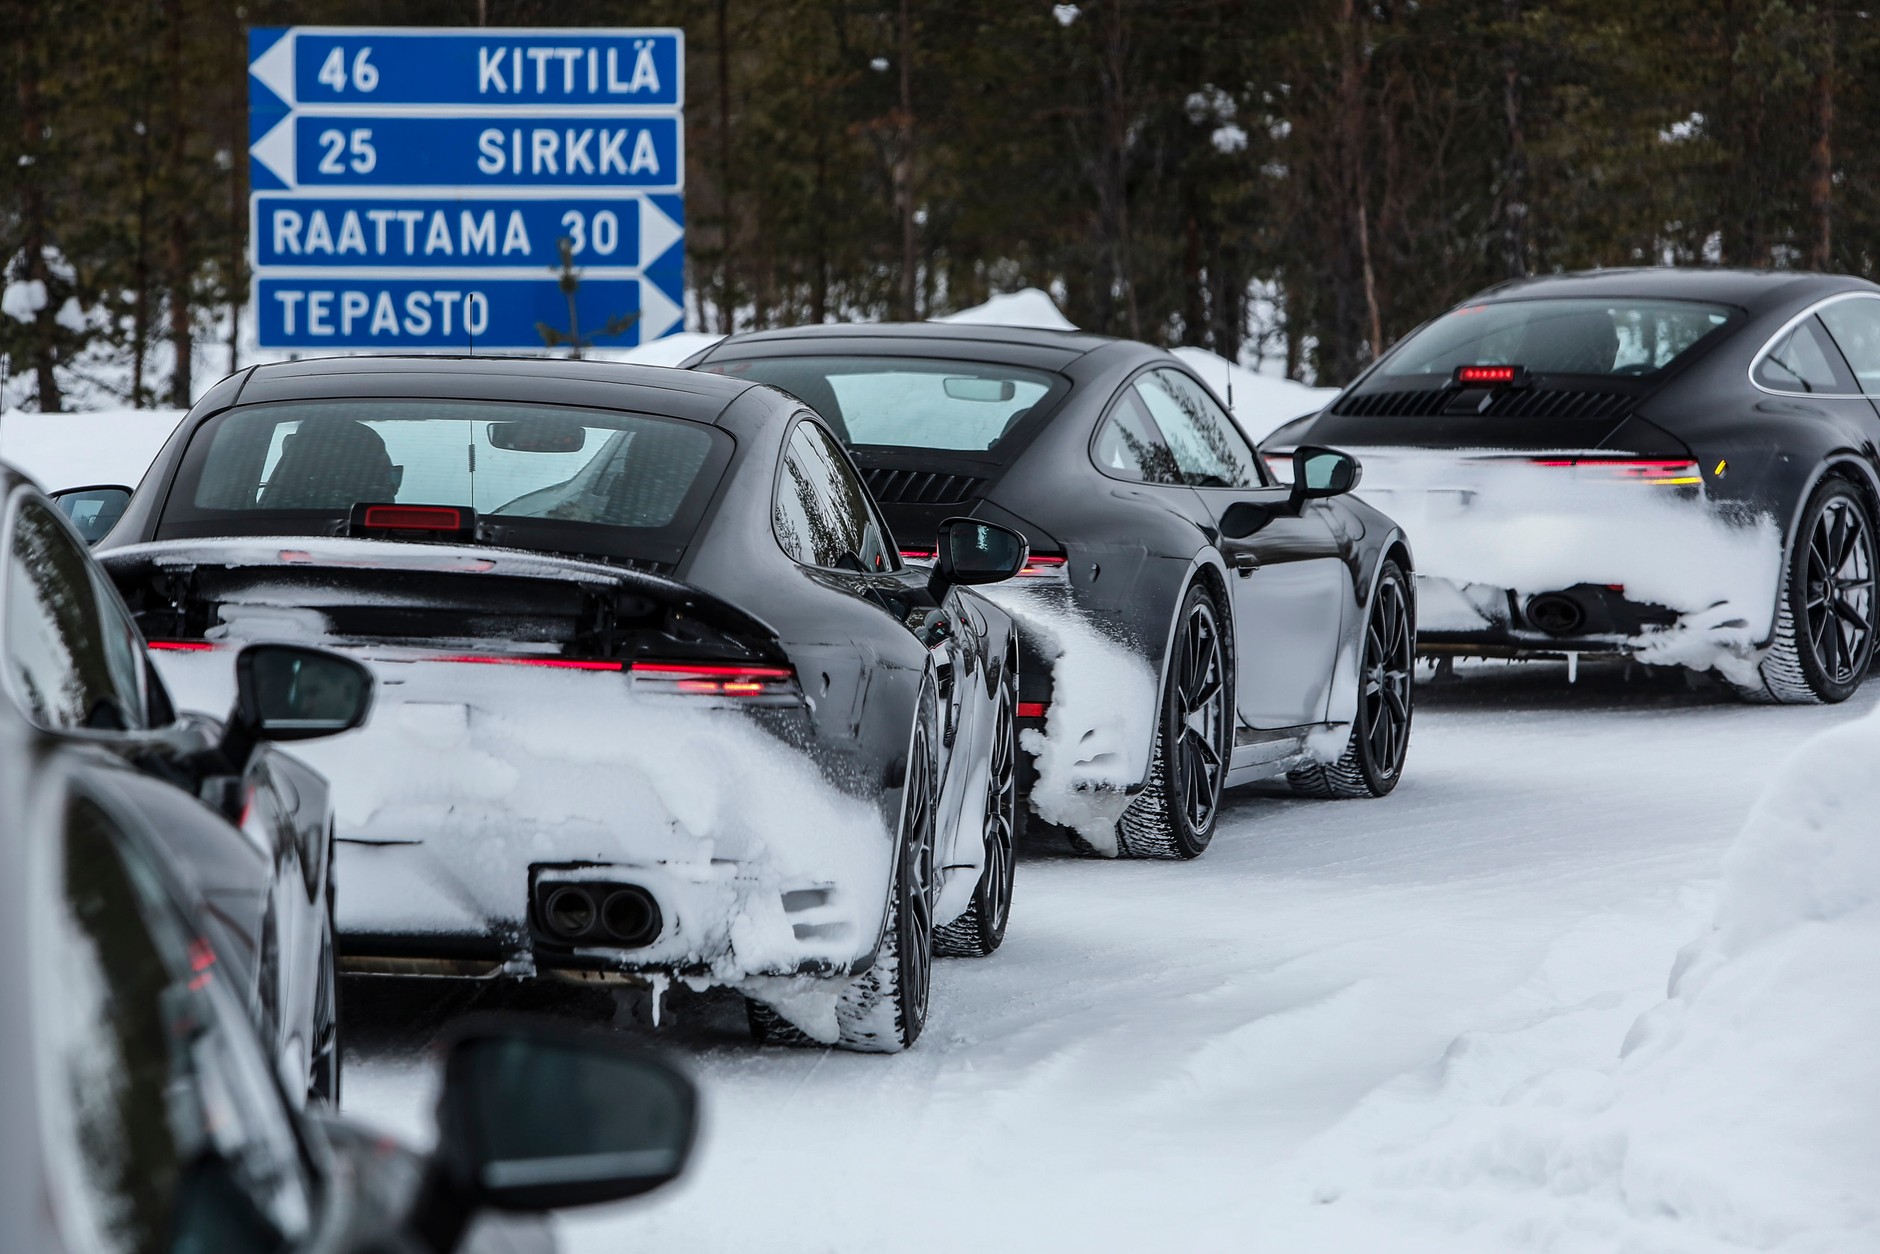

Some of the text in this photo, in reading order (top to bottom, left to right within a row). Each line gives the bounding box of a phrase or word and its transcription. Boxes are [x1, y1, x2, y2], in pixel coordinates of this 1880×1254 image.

[318, 39, 660, 93] 46 KITTILÄ
[319, 129, 660, 175] 25 SIRKKA
[273, 209, 618, 256] RAATTAMA 30
[275, 291, 489, 336] TEPASTO
